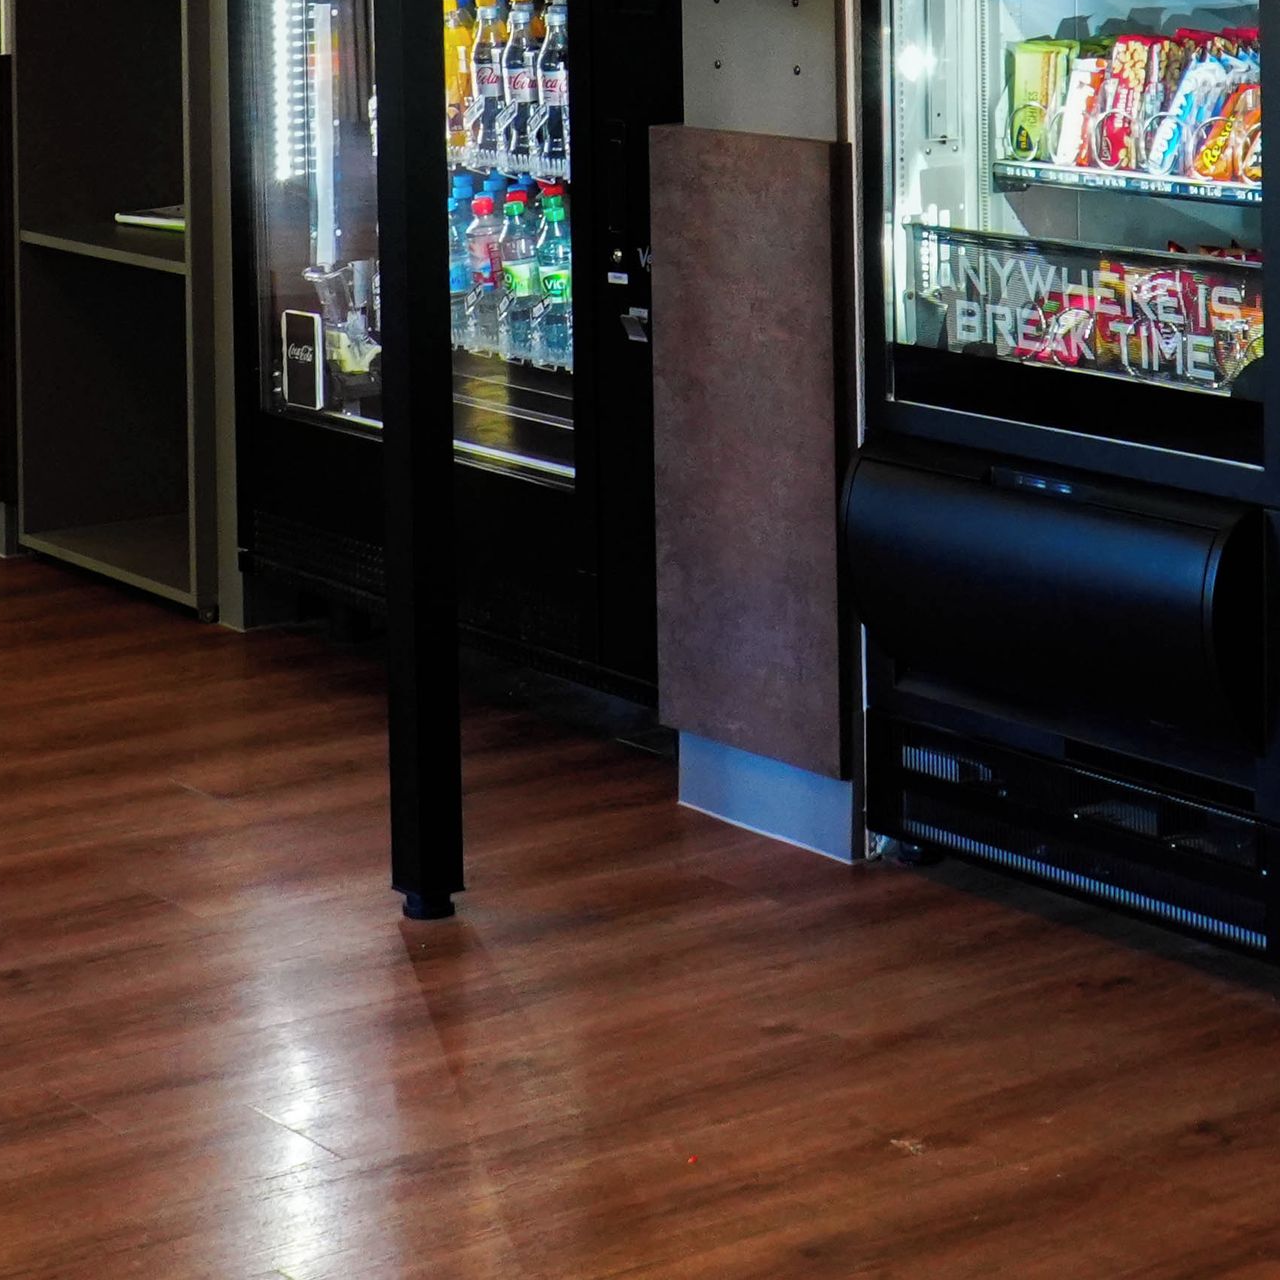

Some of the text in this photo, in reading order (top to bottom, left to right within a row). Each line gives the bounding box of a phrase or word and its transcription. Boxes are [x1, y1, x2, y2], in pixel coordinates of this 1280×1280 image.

[1197, 284, 1245, 330] IS
[955, 299, 1216, 381] BREAK TIME
